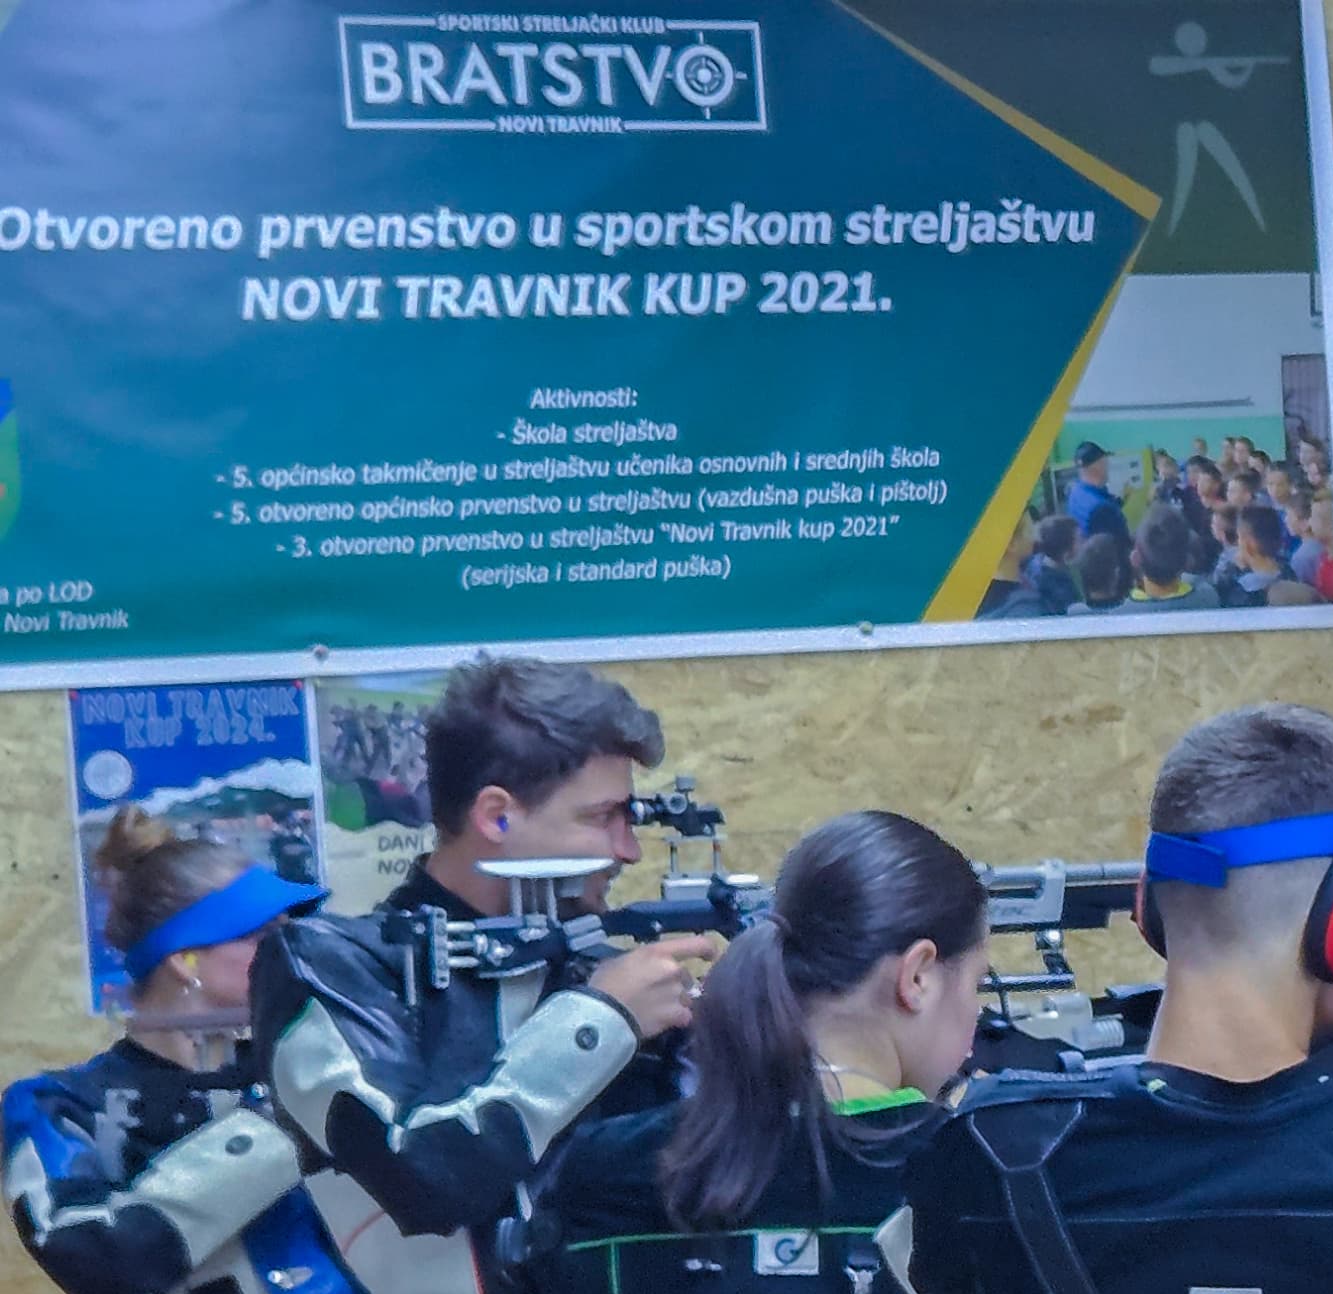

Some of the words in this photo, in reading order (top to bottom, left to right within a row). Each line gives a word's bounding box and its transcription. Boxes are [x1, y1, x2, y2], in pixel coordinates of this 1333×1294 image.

[437, 15, 519, 32] SPORTSKI
[620, 16, 665, 34] KLUB
[360, 41, 736, 107] BRATSTVO
[499, 116, 545, 132] NOVI
[547, 116, 622, 132] TRAVNIK
[0, 206, 243, 251] Otvoreno
[257, 206, 517, 260] prvenstvo
[529, 214, 561, 247] u
[574, 202, 833, 256] sportskom
[845, 197, 1096, 253] streljaštvu
[241, 275, 382, 320] NOVI
[396, 272, 632, 319] TRAVNIK
[643, 271, 747, 316] KUP
[758, 271, 893, 313] 2021.
[530, 387, 638, 410] Aktivnosti:
[511, 417, 567, 445] Škola
[572, 418, 678, 447] streljaštva
[232, 464, 252, 489] 5.
[260, 462, 355, 490] općinsko
[362, 458, 478, 487] takmičenje
[484, 464, 498, 480] u
[503, 454, 610, 482] streljaštvu
[616, 452, 694, 476] učenika
[699, 450, 787, 474] osnovnih
[794, 450, 801, 471] i
[805, 448, 885, 473] srednjih
[890, 446, 941, 469] škola
[230, 501, 251, 525] 5.
[258, 500, 354, 524] otvoreno
[360, 496, 454, 523] općinsko
[460, 494, 562, 520] prvenstvo
[567, 498, 582, 513] u
[588, 488, 692, 515] streljaštvu
[697, 482, 799, 513] (vazdušna
[804, 481, 863, 508] puška
[868, 481, 875, 501] i
[881, 479, 949, 506] pištolj)
[291, 534, 313, 558] 3.
[319, 534, 415, 557] otvoreno
[421, 529, 523, 557] prvenstvo
[529, 533, 545, 549] u
[549, 523, 655, 551] streljaštvu
[720, 518, 793, 542] Travnik
[798, 517, 835, 544] kup
[462, 563, 549, 591] (serijska
[567, 556, 658, 582] standard
[663, 553, 732, 581] puška)
[16, 587, 43, 608] po
[49, 579, 94, 604] LOD
[4, 612, 50, 634] Novi
[57, 608, 130, 633] Travnik
[81, 690, 157, 725] NOVI
[169, 687, 300, 721] TRAVNIK
[123, 716, 183, 750] KUP
